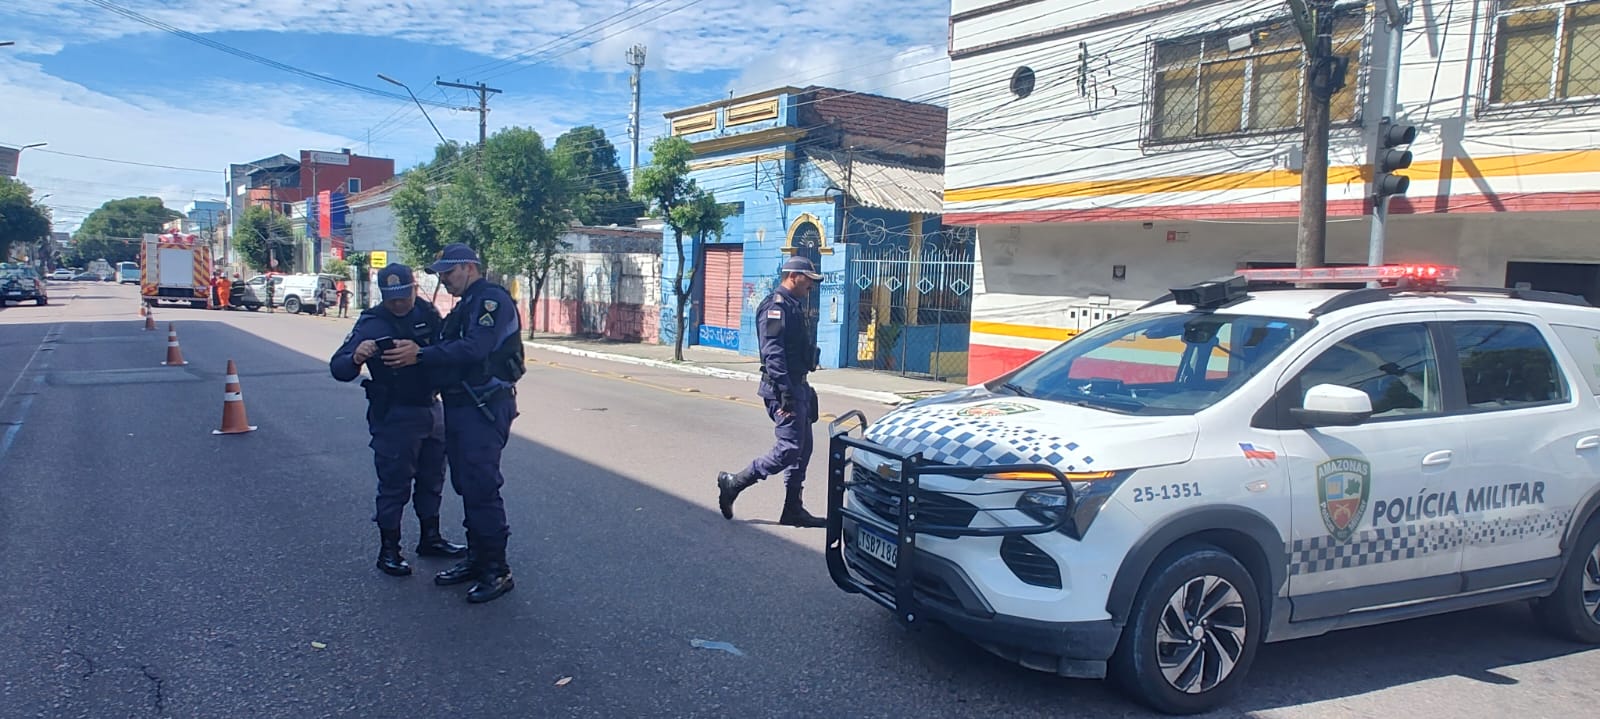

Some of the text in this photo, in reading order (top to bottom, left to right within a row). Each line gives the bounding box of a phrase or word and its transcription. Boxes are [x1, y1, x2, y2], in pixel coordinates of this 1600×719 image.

[1318, 459, 1368, 480] AMAZONAS
[1133, 482, 1202, 503] 25-1351
[1372, 481, 1545, 527] POLÍCIA MILITAR
